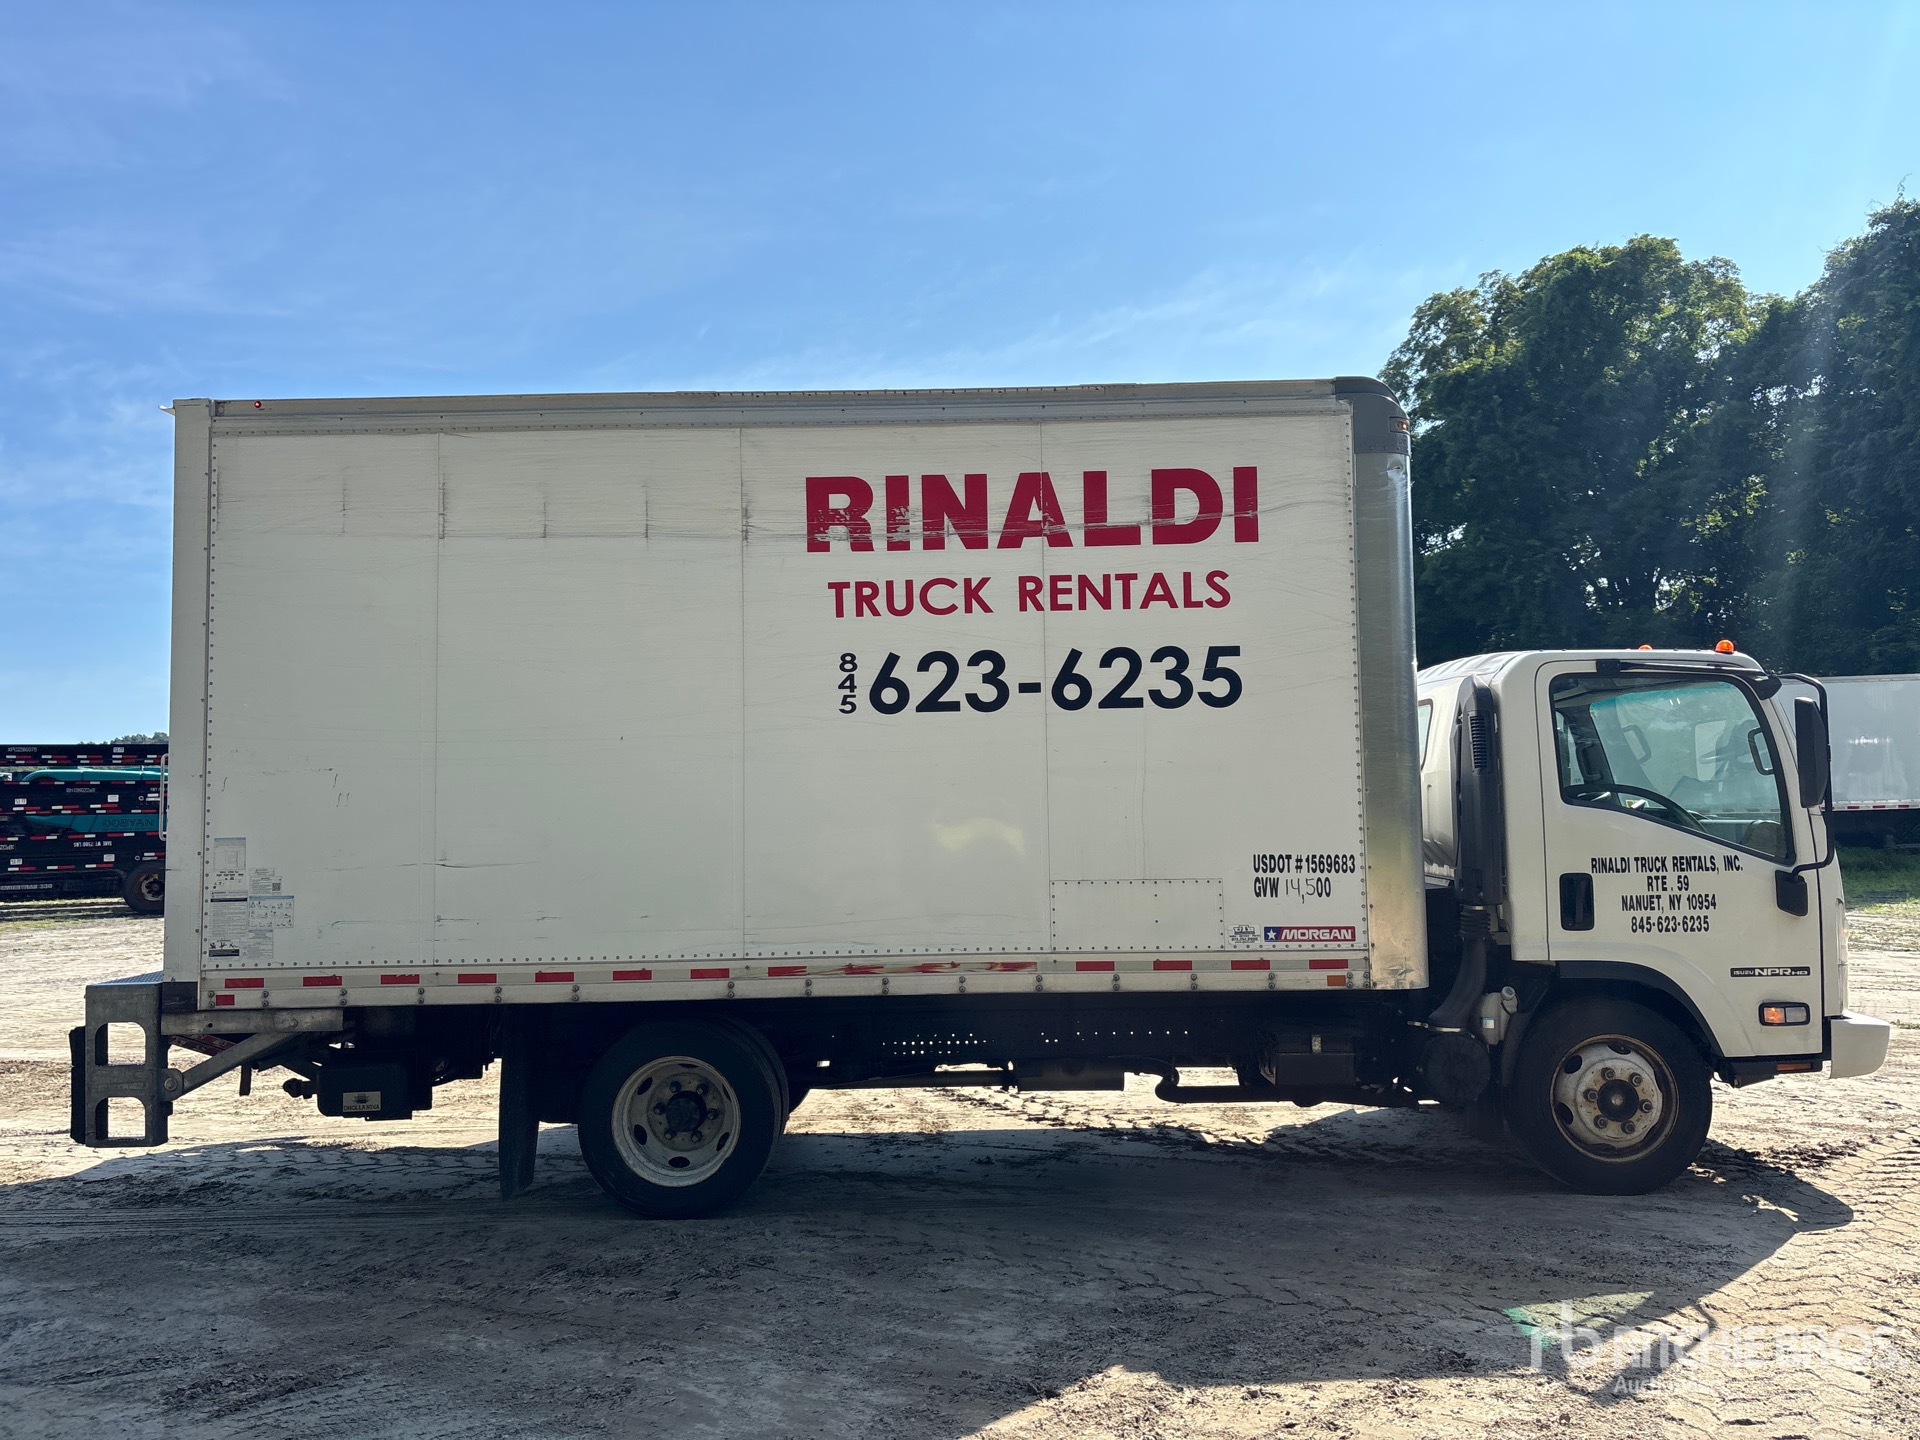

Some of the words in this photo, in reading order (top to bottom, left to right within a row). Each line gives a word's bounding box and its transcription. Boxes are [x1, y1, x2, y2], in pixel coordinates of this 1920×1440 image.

[806, 467, 1259, 553] RINALDI
[828, 577, 994, 618] TRUCK
[1018, 570, 1231, 612] RENTALS
[869, 645, 1243, 715] 623-6235
[1253, 854, 1292, 873] USDOT
[1590, 856, 1631, 873] RINALDI
[1634, 855, 1668, 873] TRUCK
[1672, 855, 1719, 874] RENTALS,
[1723, 855, 1743, 872] INC.
[1254, 877, 1279, 898] GVW
[1677, 875, 1690, 891] 59
[1621, 895, 1664, 913] NANUET,
[1669, 894, 1682, 911] NY
[1687, 893, 1717, 911] 10954
[1631, 915, 1710, 933] 845-623-6235
[1281, 929, 1352, 940] MORGAN
[1754, 968, 1792, 976] NPR
